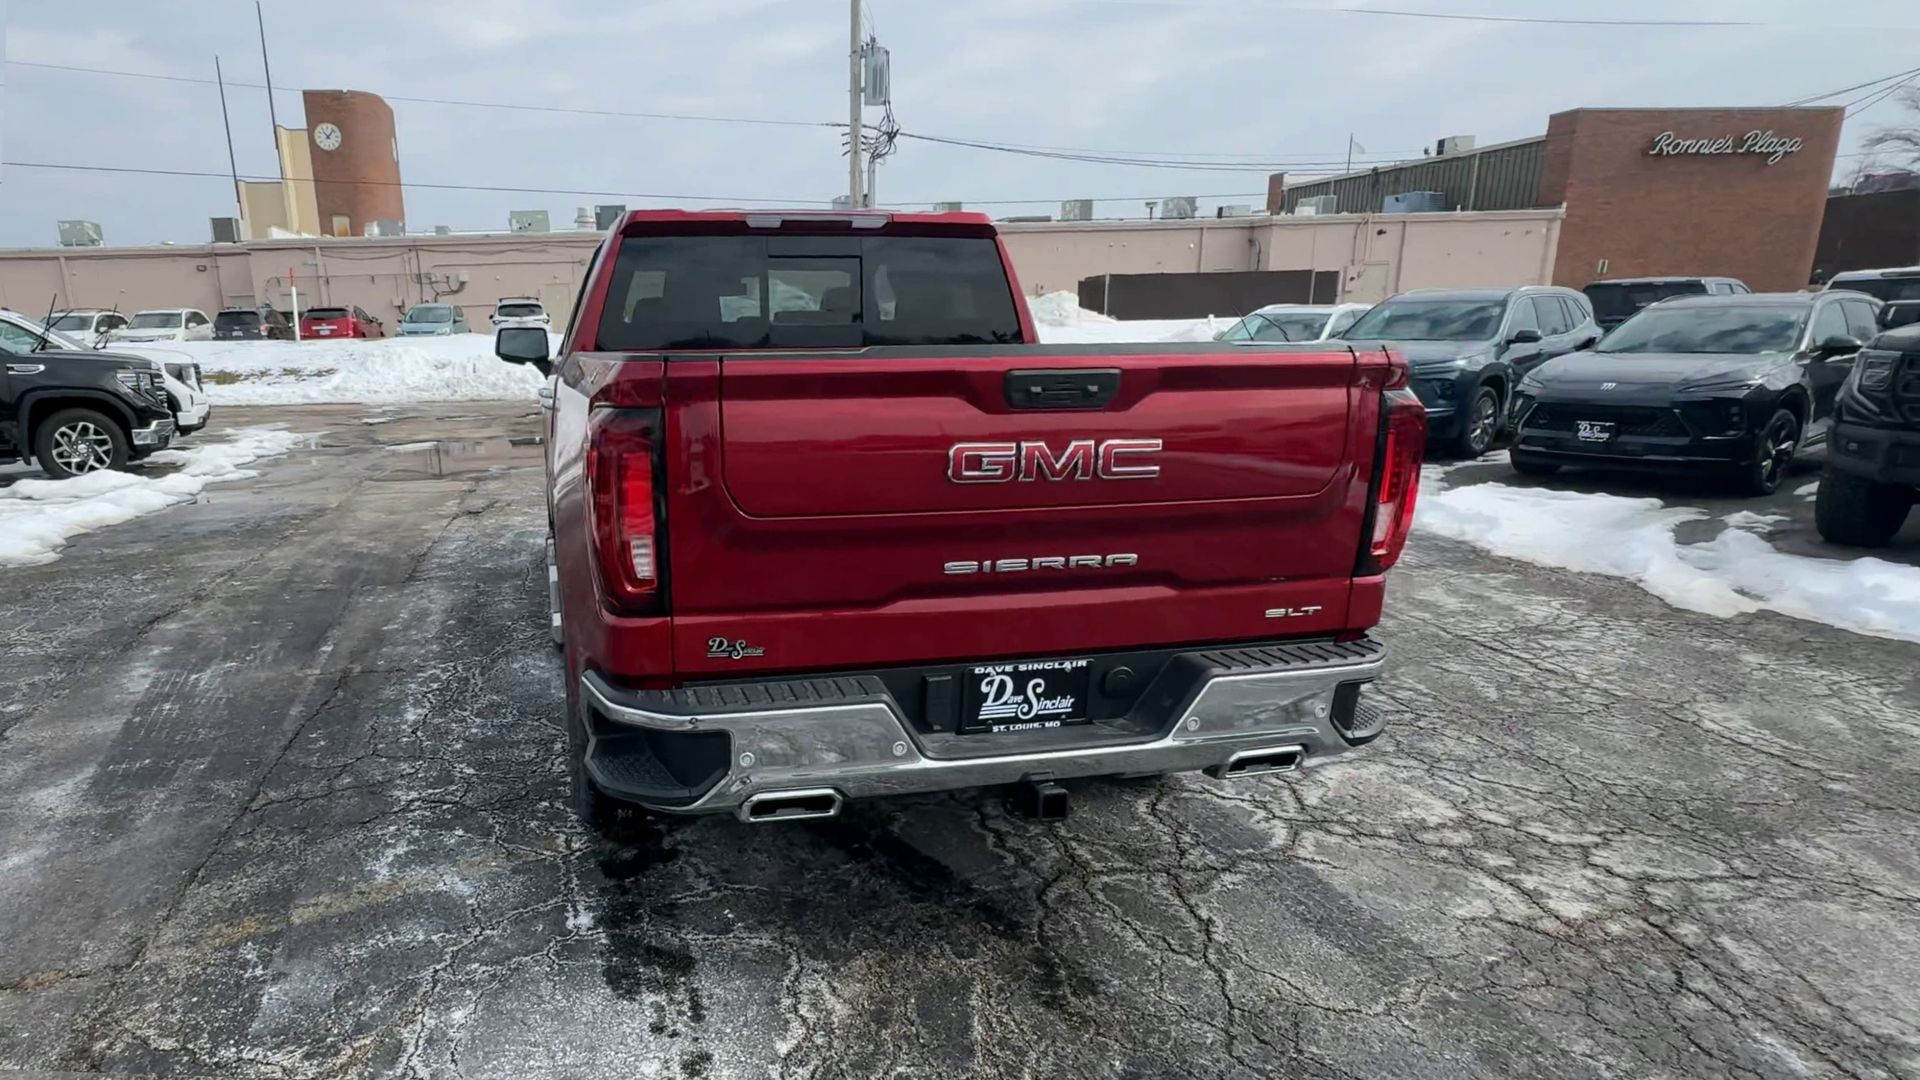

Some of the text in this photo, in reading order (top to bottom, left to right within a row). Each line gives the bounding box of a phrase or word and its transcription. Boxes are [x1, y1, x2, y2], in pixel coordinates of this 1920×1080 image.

[1649, 130, 1803, 165] Ronnie's Plaza
[948, 438, 1163, 484] GMC
[944, 553, 1138, 574] SIERRA
[1265, 606, 1322, 618] SLT
[974, 660, 1088, 674] DAVE SINCLAIR
[980, 674, 1075, 719] Dave Sinclair
[992, 725, 1008, 733] ST.
[1045, 720, 1061, 728] MO
